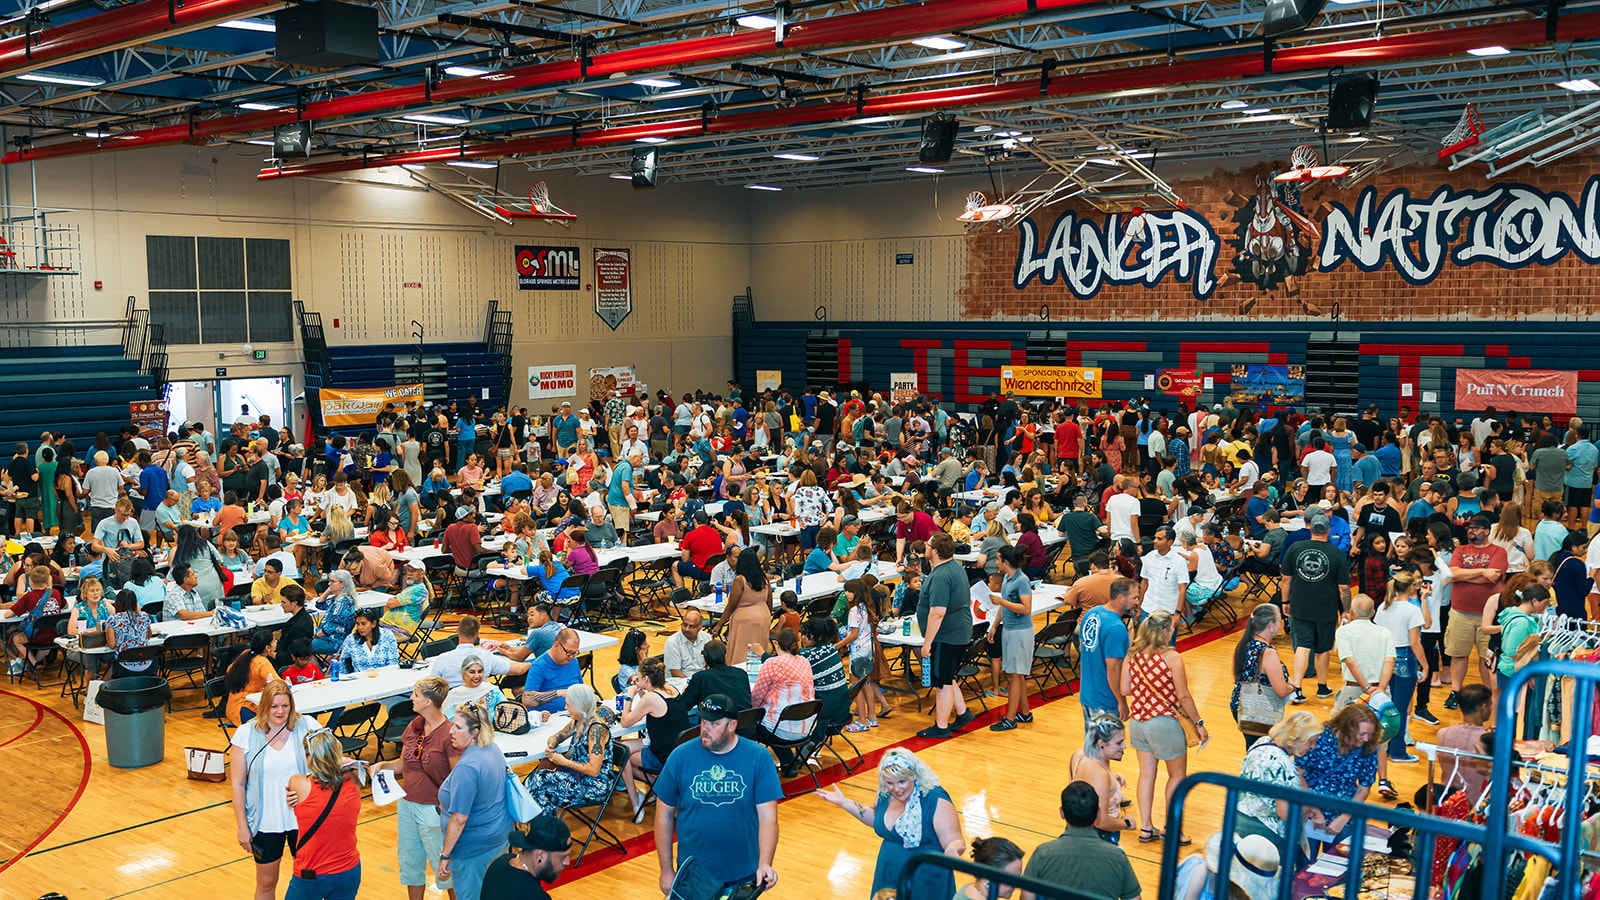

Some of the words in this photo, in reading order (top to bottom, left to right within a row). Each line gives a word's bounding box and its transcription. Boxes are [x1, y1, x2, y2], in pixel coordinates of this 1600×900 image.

[1017, 211, 1216, 296] LANCER
[1319, 178, 1600, 282] NATION
[1023, 369, 1067, 377] SPONSORED
[540, 379, 574, 390] MOMO
[894, 381, 914, 390] PARTY
[1004, 377, 1096, 395] Wienerschnitzel
[1466, 383, 1495, 395] Puff
[384, 388, 398, 398] WE
[398, 386, 422, 397] CATER
[695, 781, 740, 793] RUGER
